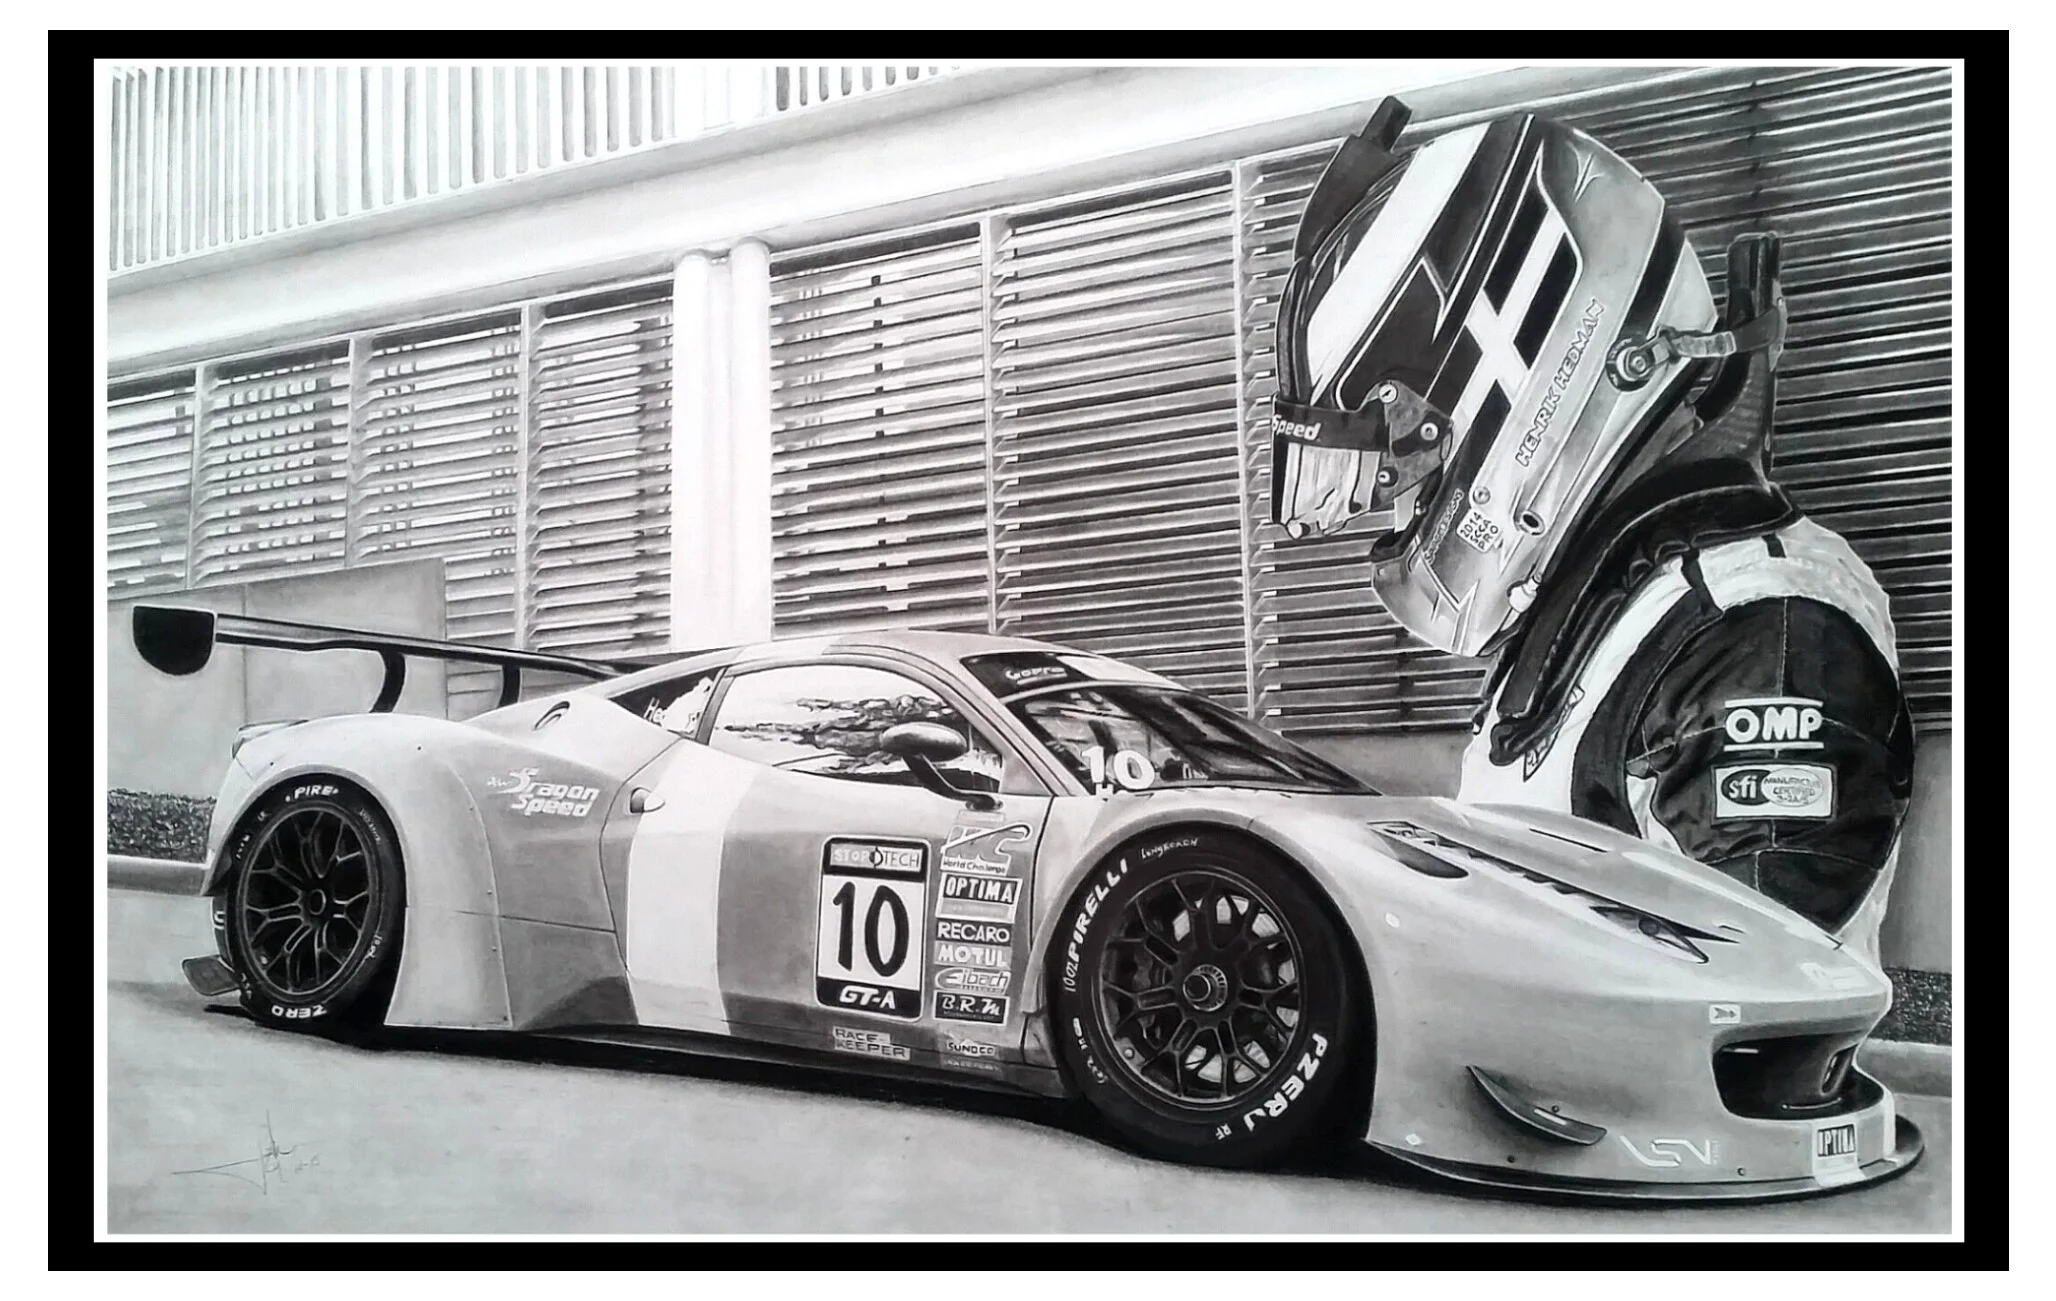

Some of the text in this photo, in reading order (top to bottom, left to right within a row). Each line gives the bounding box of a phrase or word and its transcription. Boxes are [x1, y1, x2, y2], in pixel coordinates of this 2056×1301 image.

[1515, 299, 1605, 467] HENRIK HEDMAN
[1272, 414, 1322, 440] Speed
[1460, 512, 1482, 537] 2014
[1478, 526, 1499, 550] PRO
[1725, 706, 1822, 743] OMP
[1081, 745, 1155, 789] 10
[1728, 775, 1758, 799] sfi
[511, 793, 593, 817] Speed
[883, 850, 919, 868] TECH
[945, 876, 1013, 903] OPTIMA
[1068, 858, 1128, 962] PIRELLI
[832, 881, 910, 977] 10
[937, 921, 1010, 943] RECARO
[938, 944, 1008, 967] MOTUL
[839, 985, 896, 1010] GT-A
[271, 1003, 327, 1019] ZERO
[835, 1039, 905, 1057] KEEPER
